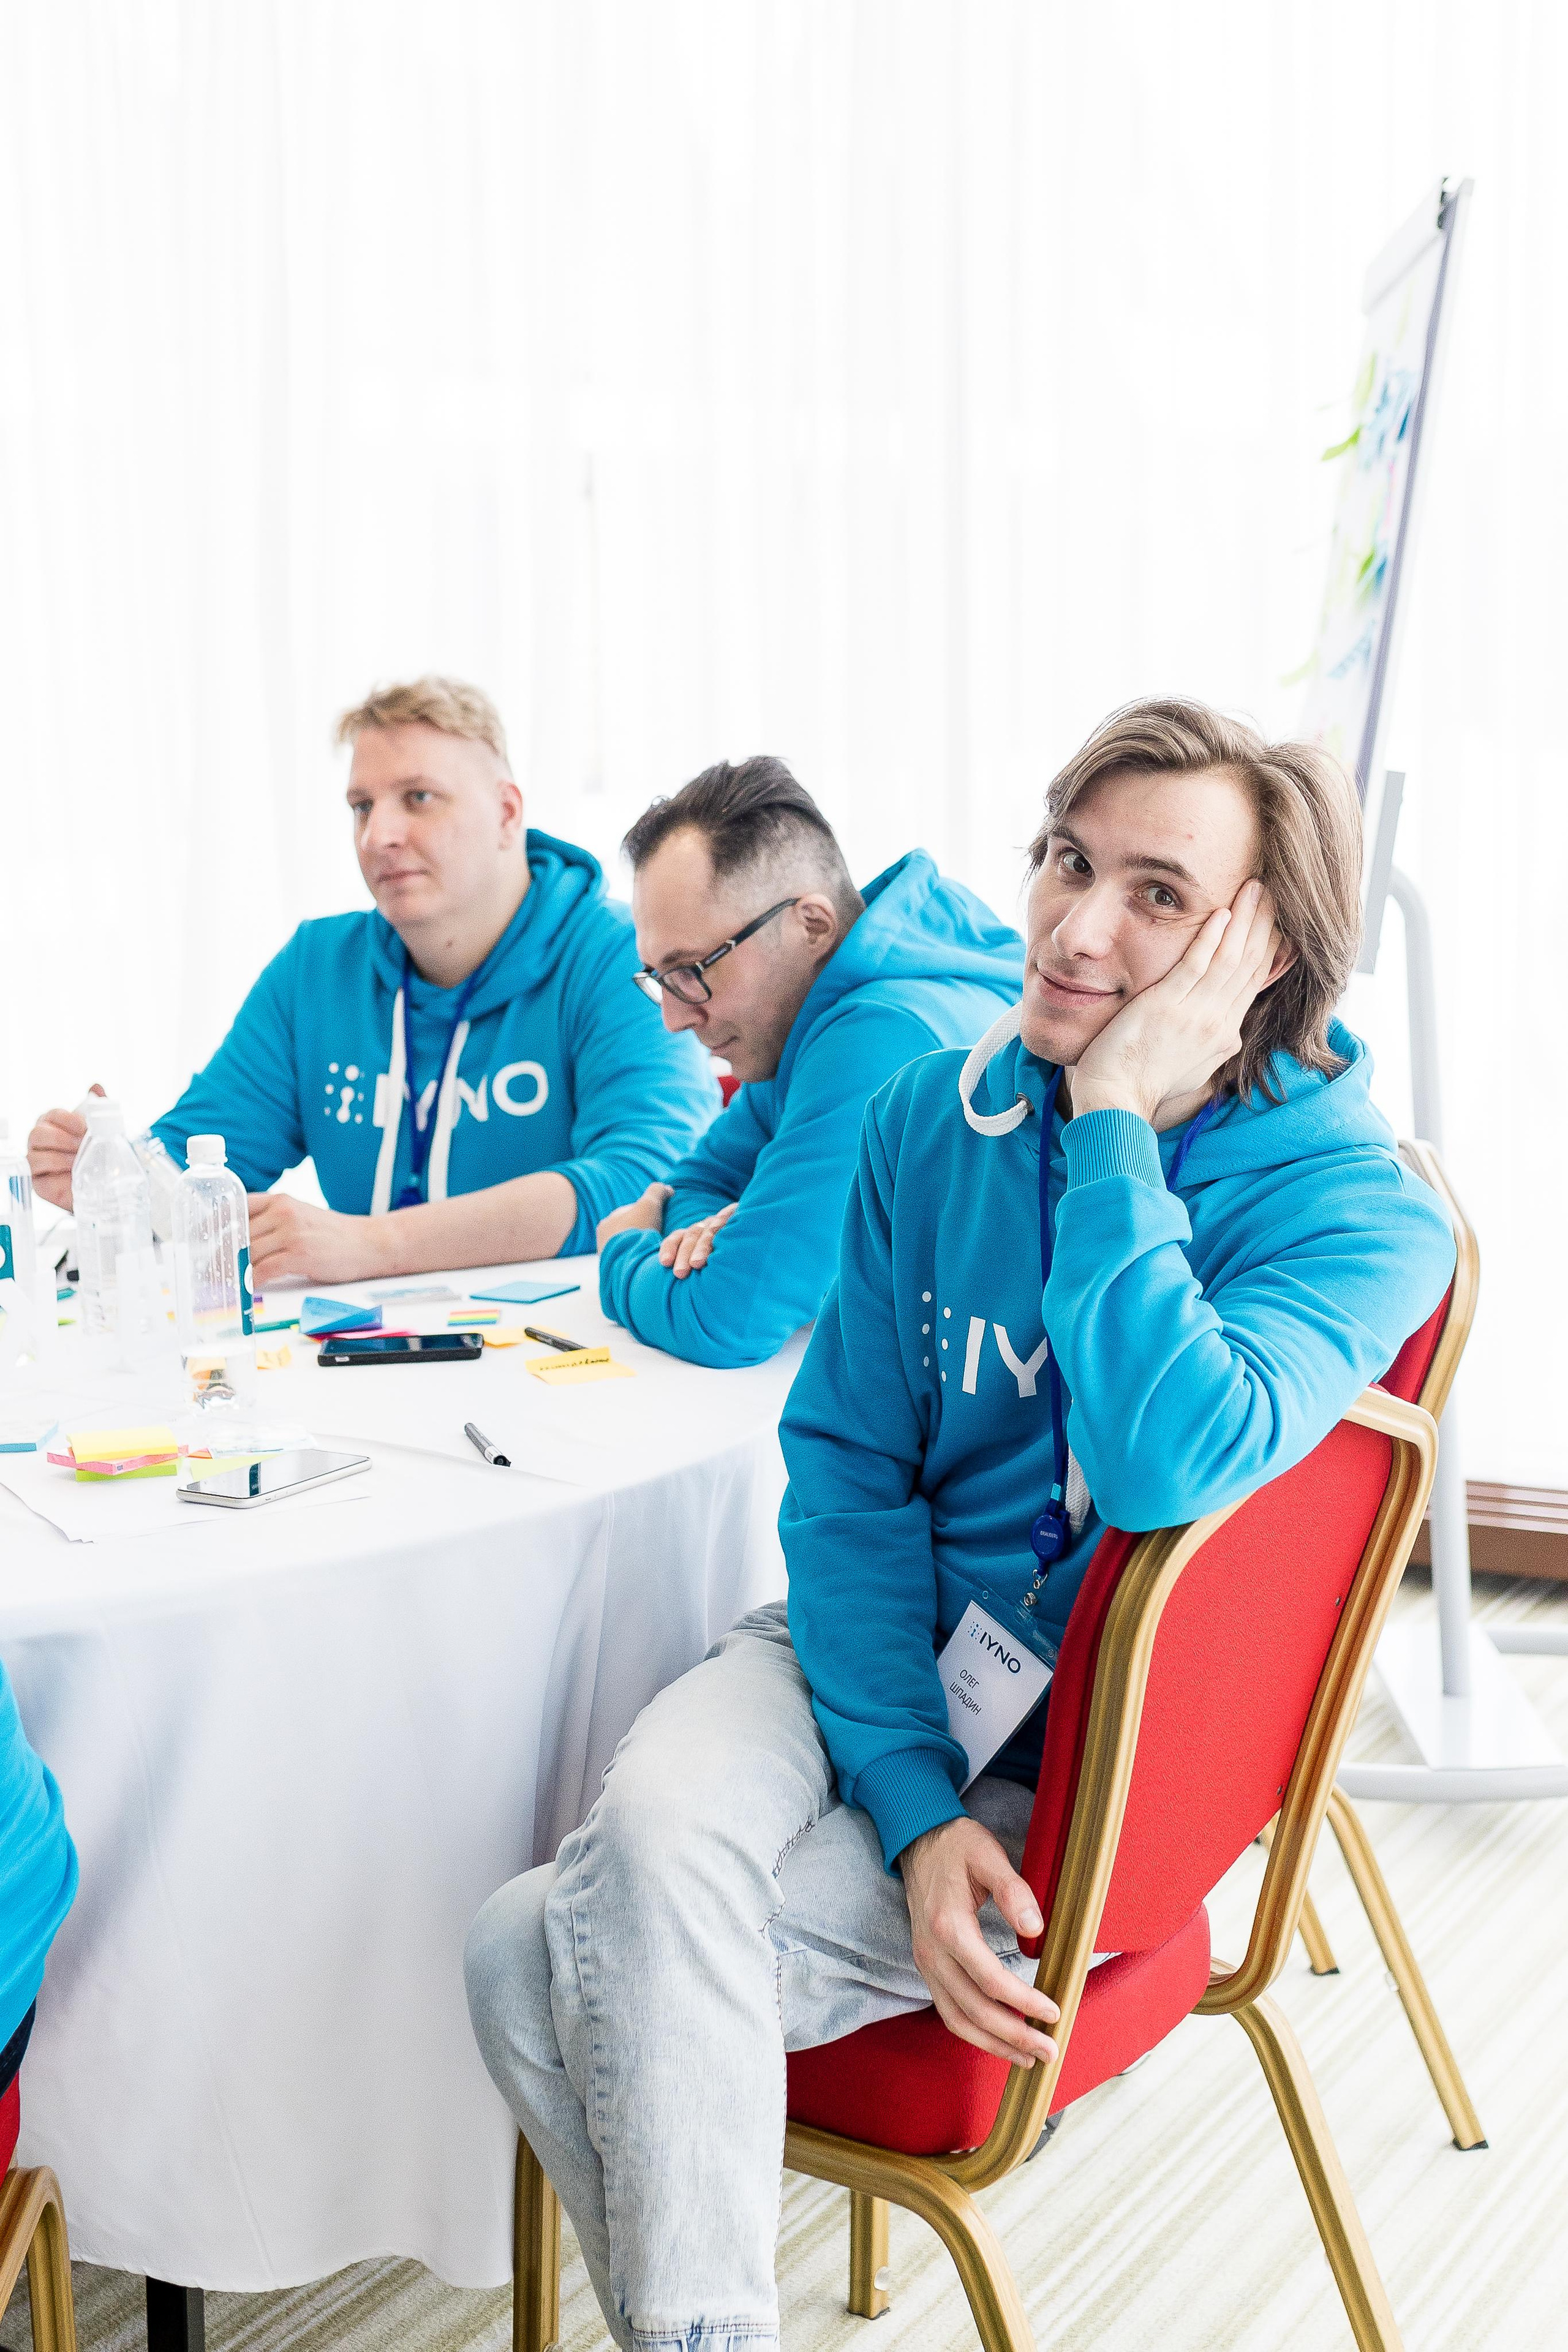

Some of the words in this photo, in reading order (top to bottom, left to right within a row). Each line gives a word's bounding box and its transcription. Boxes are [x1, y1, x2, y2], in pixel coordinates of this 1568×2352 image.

[979, 1631, 1022, 1674] IYNO
[959, 1669, 980, 1689] ОЛЕГ
[949, 1681, 982, 1716] ШПАДИН
